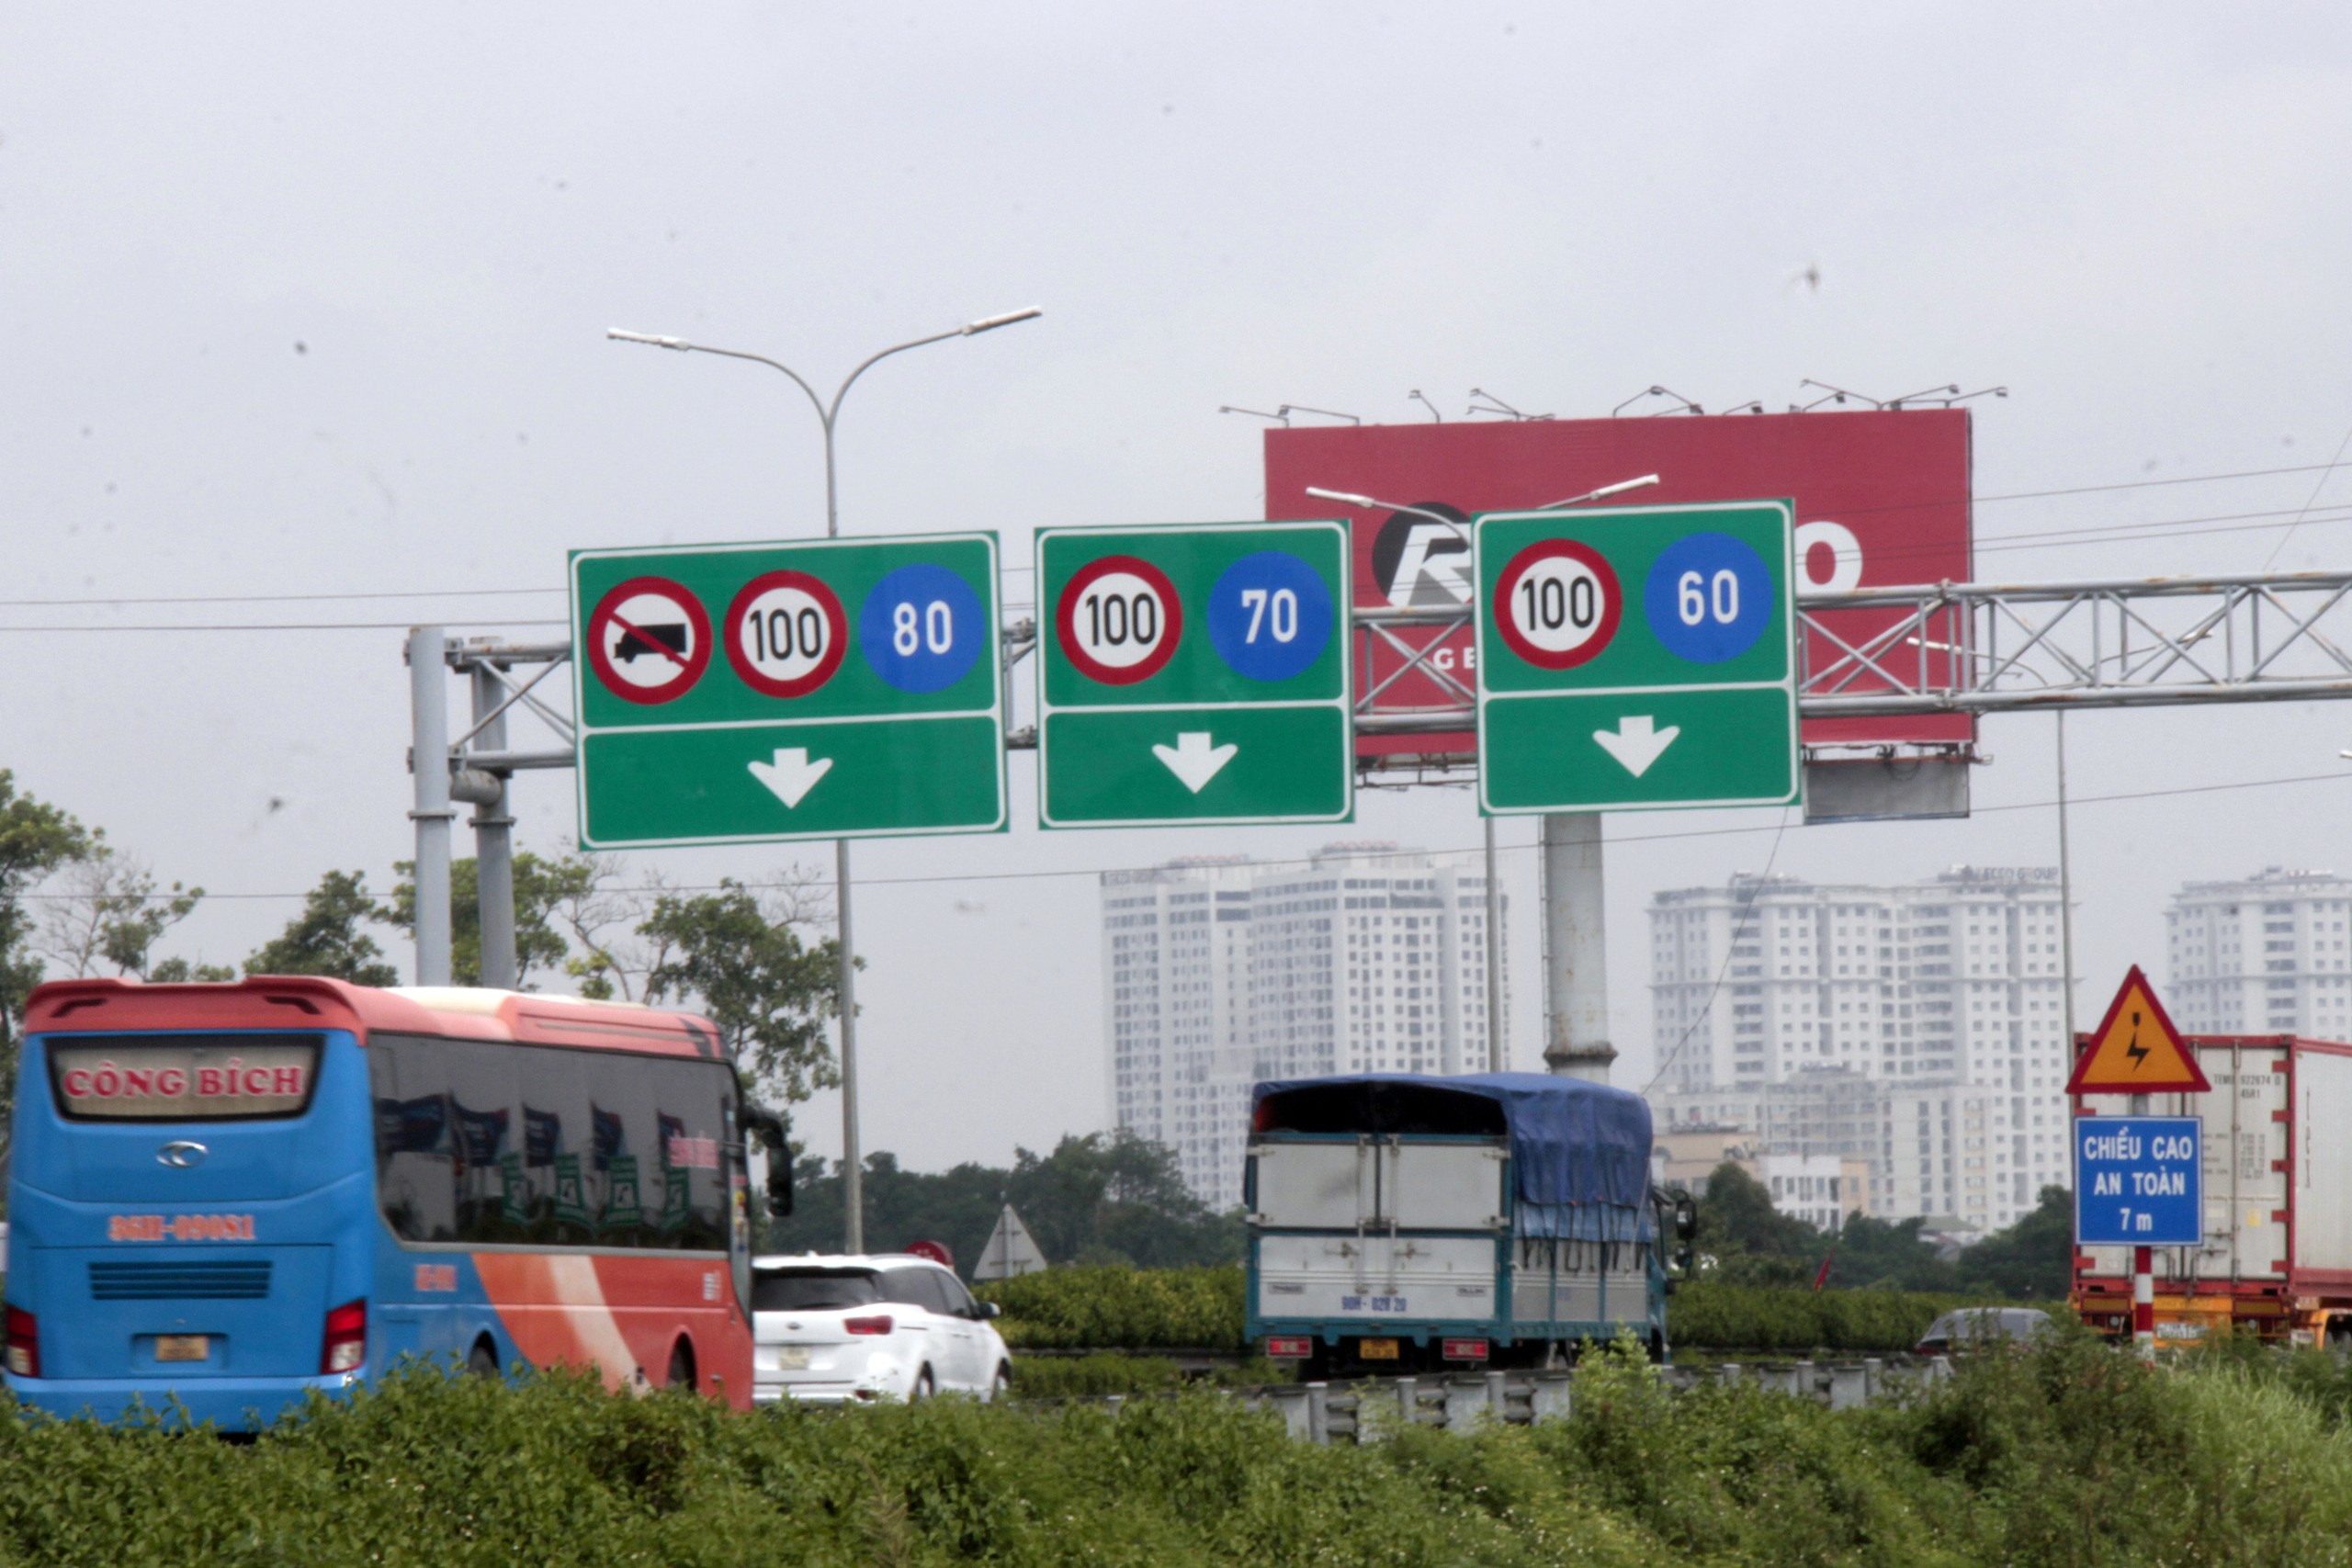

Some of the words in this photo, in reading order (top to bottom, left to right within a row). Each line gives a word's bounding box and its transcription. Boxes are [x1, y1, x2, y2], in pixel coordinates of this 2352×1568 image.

[1085, 592, 1157, 647] 100
[1241, 588, 1298, 643] 70
[1521, 575, 1595, 631] 100
[1678, 569, 1739, 626] 60
[749, 606, 822, 662] 100
[893, 600, 953, 657] 80
[62, 1059, 188, 1098] CÔNG
[2152, 1136, 2193, 1160] CAO
[2094, 1172, 2122, 1195] AN
[2132, 1165, 2186, 1196] TOÀN
[2119, 1208, 2132, 1231] 7
[2135, 1213, 2153, 1231] m
